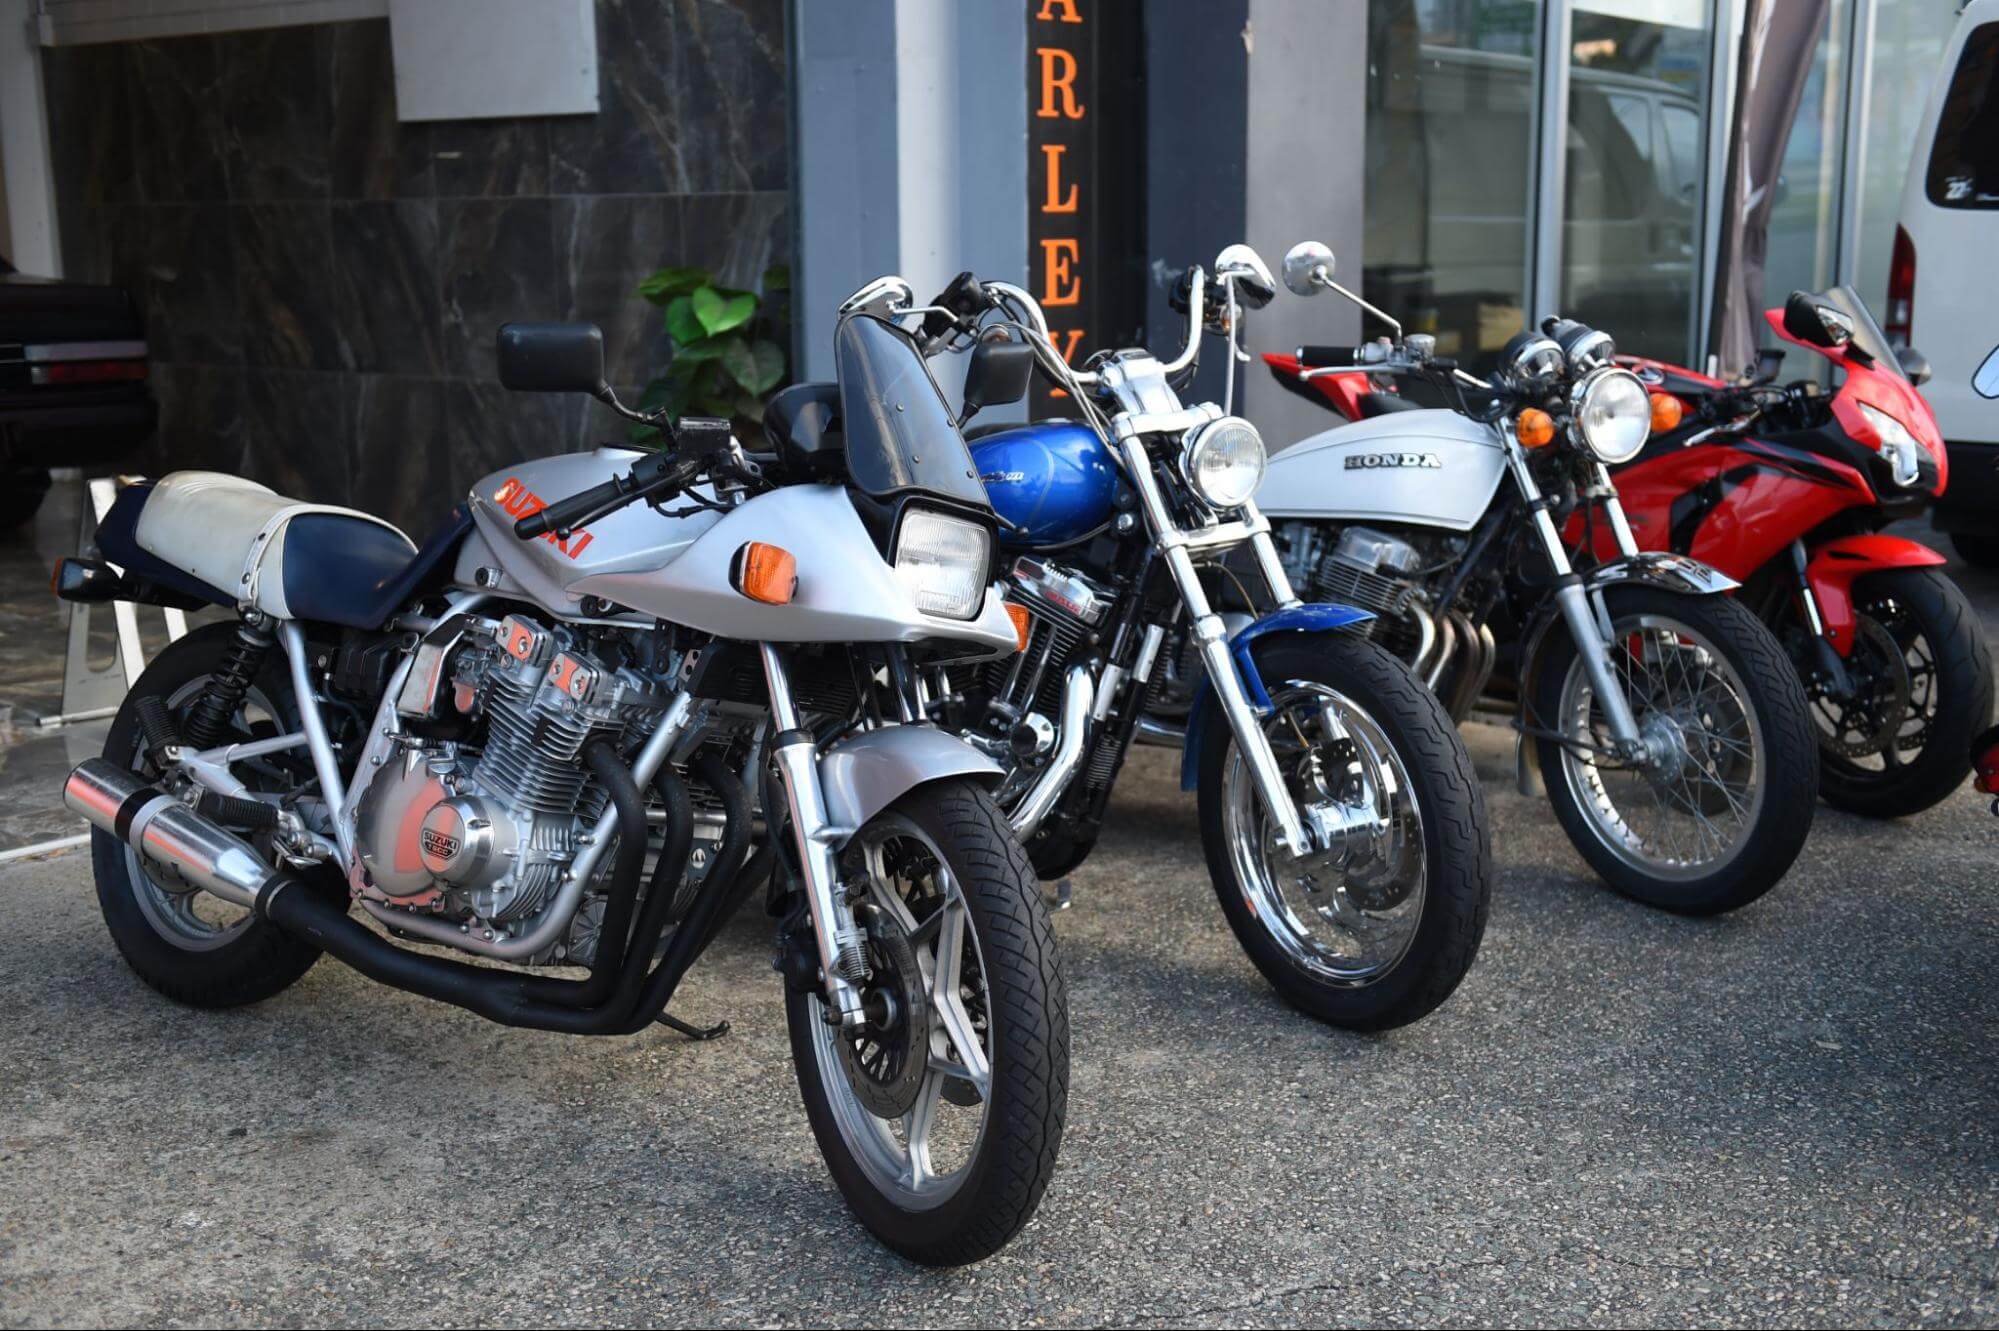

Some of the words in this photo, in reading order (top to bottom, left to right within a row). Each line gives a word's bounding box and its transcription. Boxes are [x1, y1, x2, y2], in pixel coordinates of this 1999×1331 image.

[1344, 453, 1441, 470] HONDA
[494, 478, 594, 560] SUZI
[423, 831, 458, 850] SUZUKI
